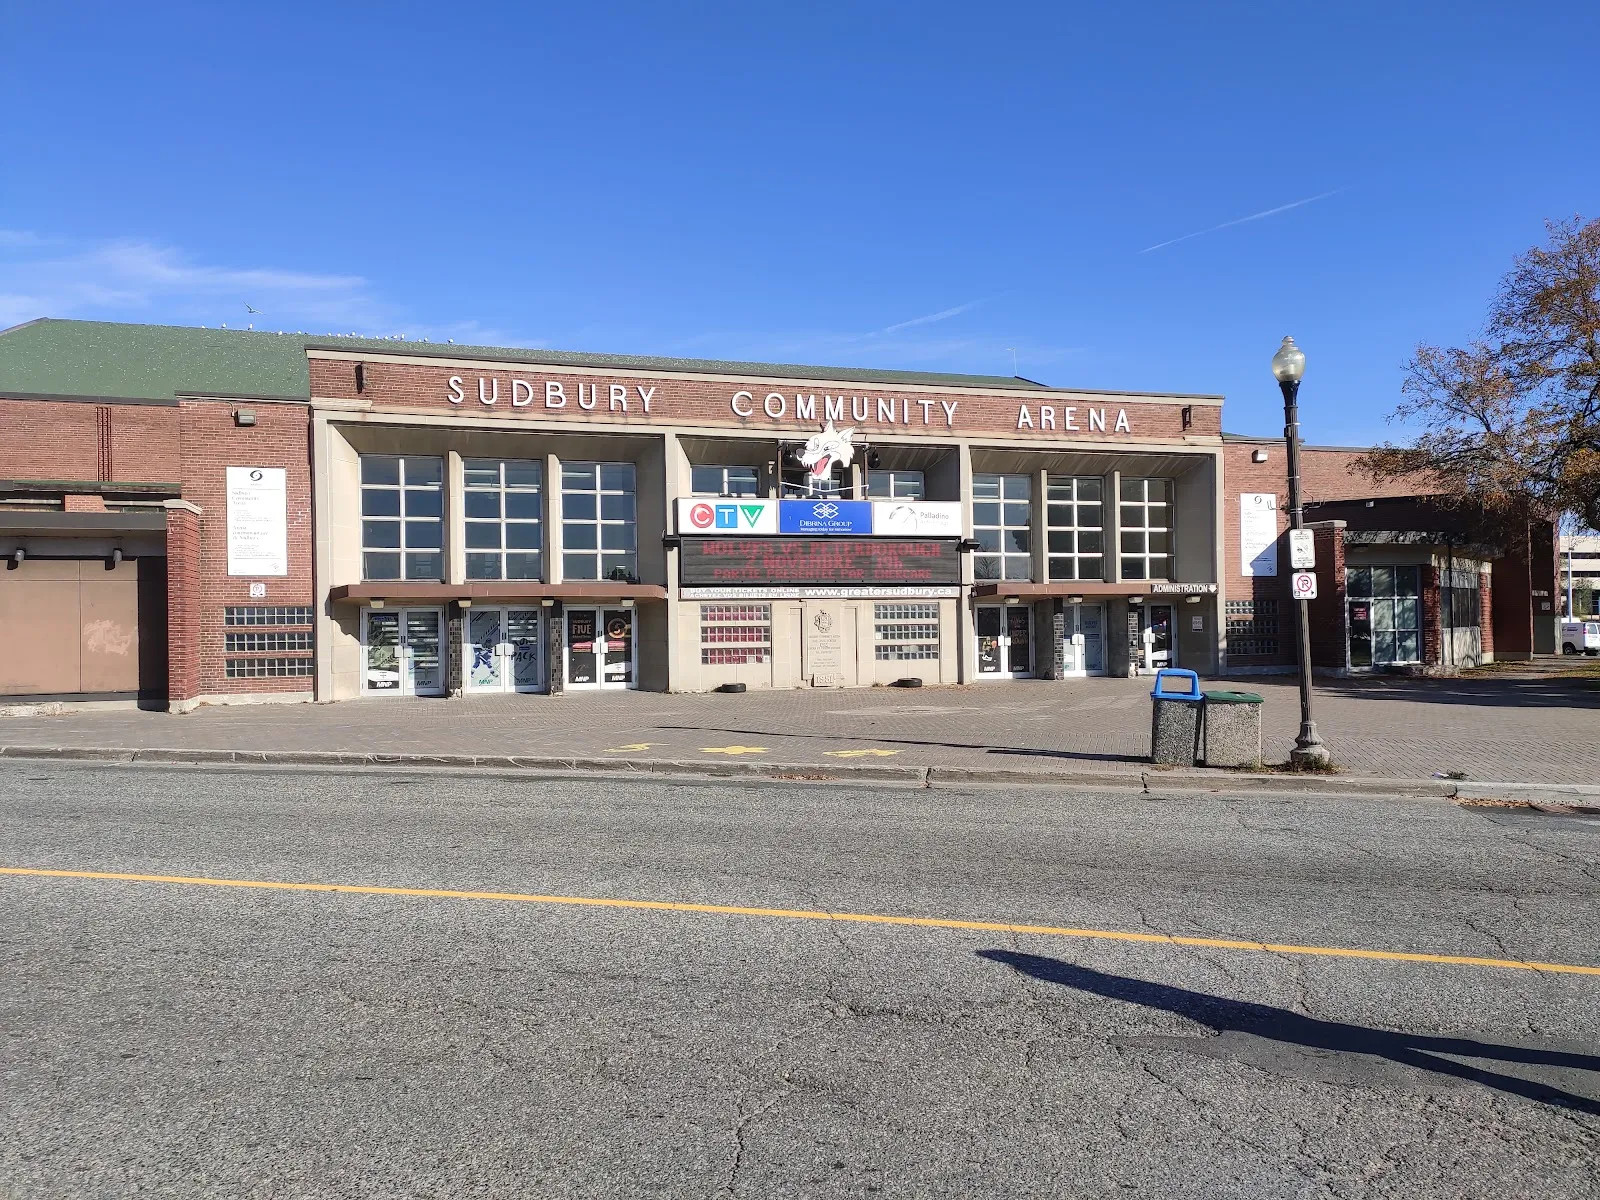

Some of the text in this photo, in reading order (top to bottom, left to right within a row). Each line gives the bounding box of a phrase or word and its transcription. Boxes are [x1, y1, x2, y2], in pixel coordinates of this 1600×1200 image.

[447, 376, 1131, 433] SUDBURY COMMUNITY ARENA
[691, 505, 763, 527] CTV
[920, 511, 950, 520] Palladino
[799, 519, 853, 527] DIBRINA GROUP
[703, 542, 941, 556] WOLVES VS PETERBOROUGH
[745, 555, 756, 568] 2
[763, 555, 855, 568] NOVEMBRE
[713, 568, 760, 578] PARTIE
[767, 568, 836, 578] PRESENTEE
[841, 569, 865, 578] PAR
[804, 587, 952, 597] www.greatersudbury.ca
[1153, 584, 1208, 593] ADMINISTRATION
[572, 624, 591, 634] FIVE
[511, 651, 537, 662] PACK
